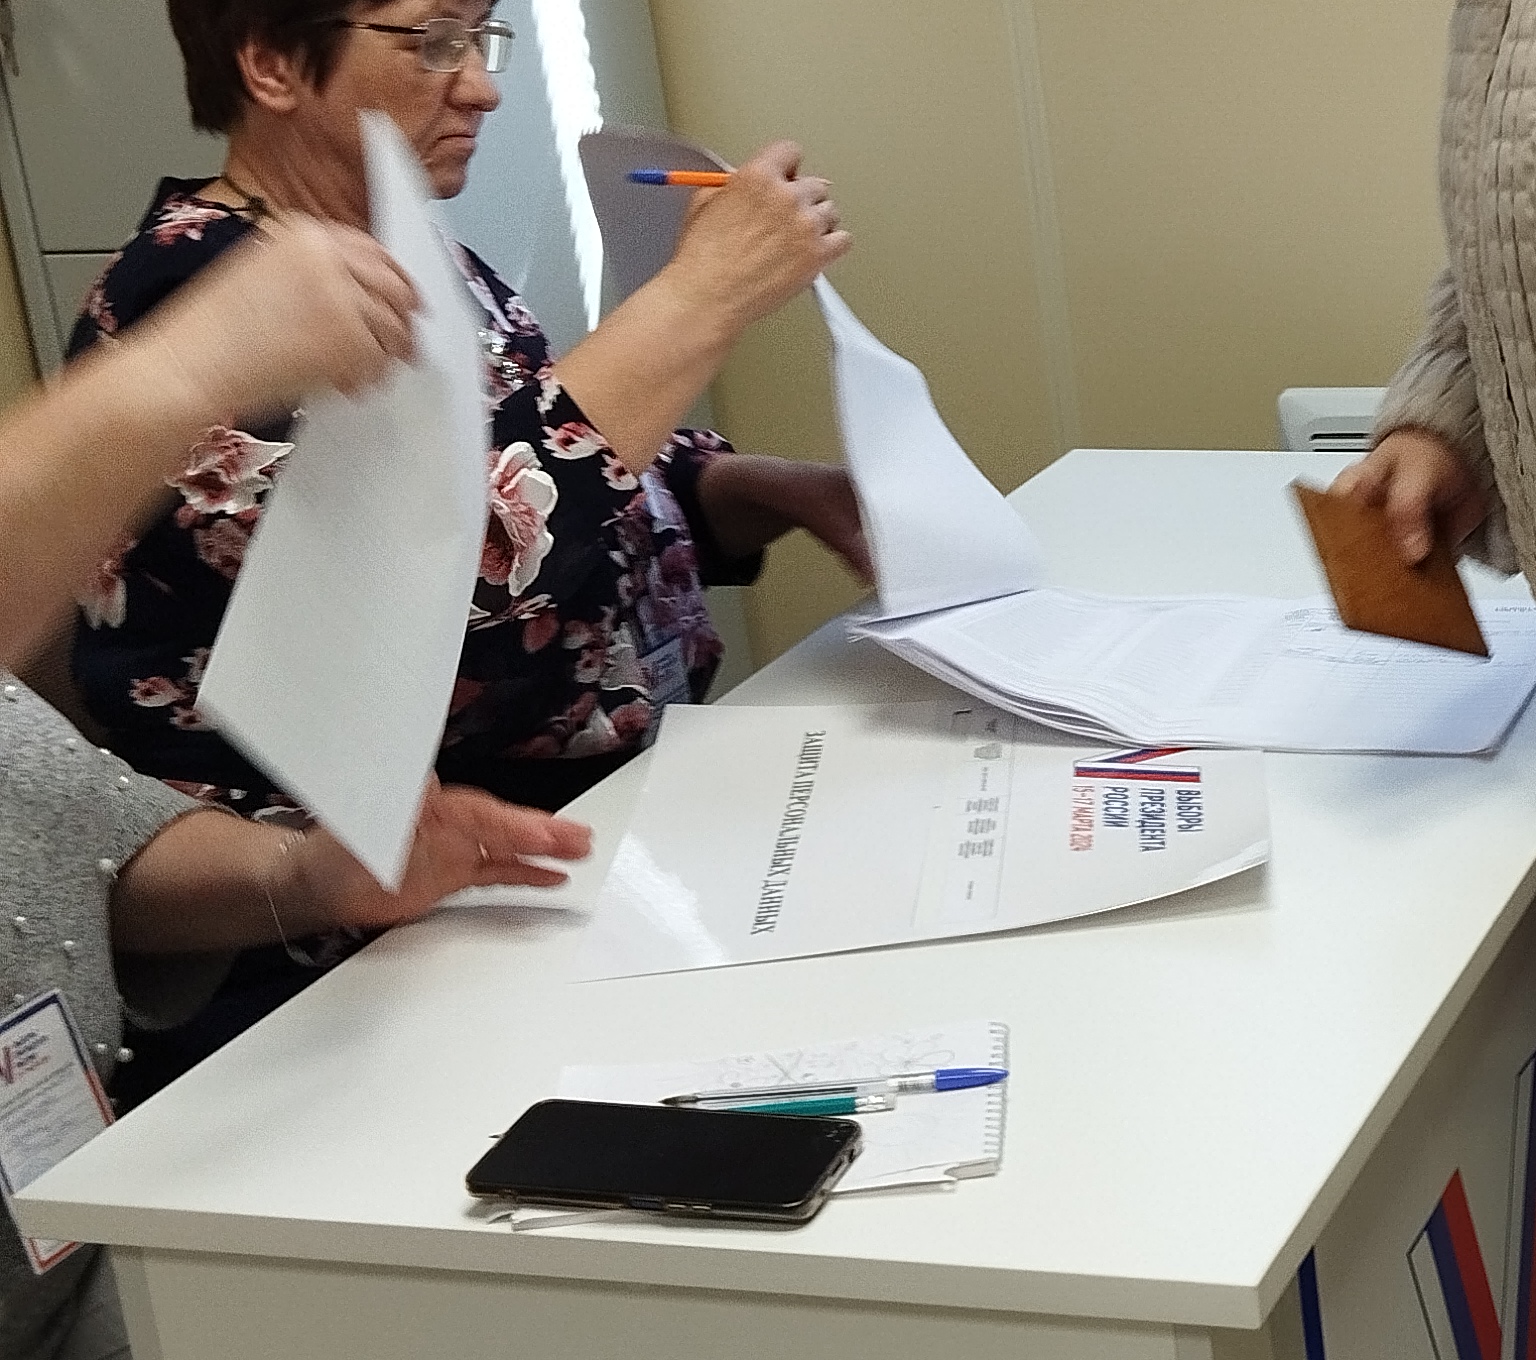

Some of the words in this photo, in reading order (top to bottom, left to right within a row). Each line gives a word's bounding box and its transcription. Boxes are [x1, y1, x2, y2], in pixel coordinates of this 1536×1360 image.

[795, 730, 826, 778] ЗАЩИТА
[767, 780, 815, 877] ПЕРСОНАЛЬНЫХ
[1071, 806, 1095, 832] МАРТА
[1102, 786, 1129, 828] РОССИИ
[1135, 788, 1167, 852] ПРЕЗИДЕНТА
[1175, 790, 1204, 833] ВЫБОРЫ
[750, 879, 788, 935] ДАННЫХ
